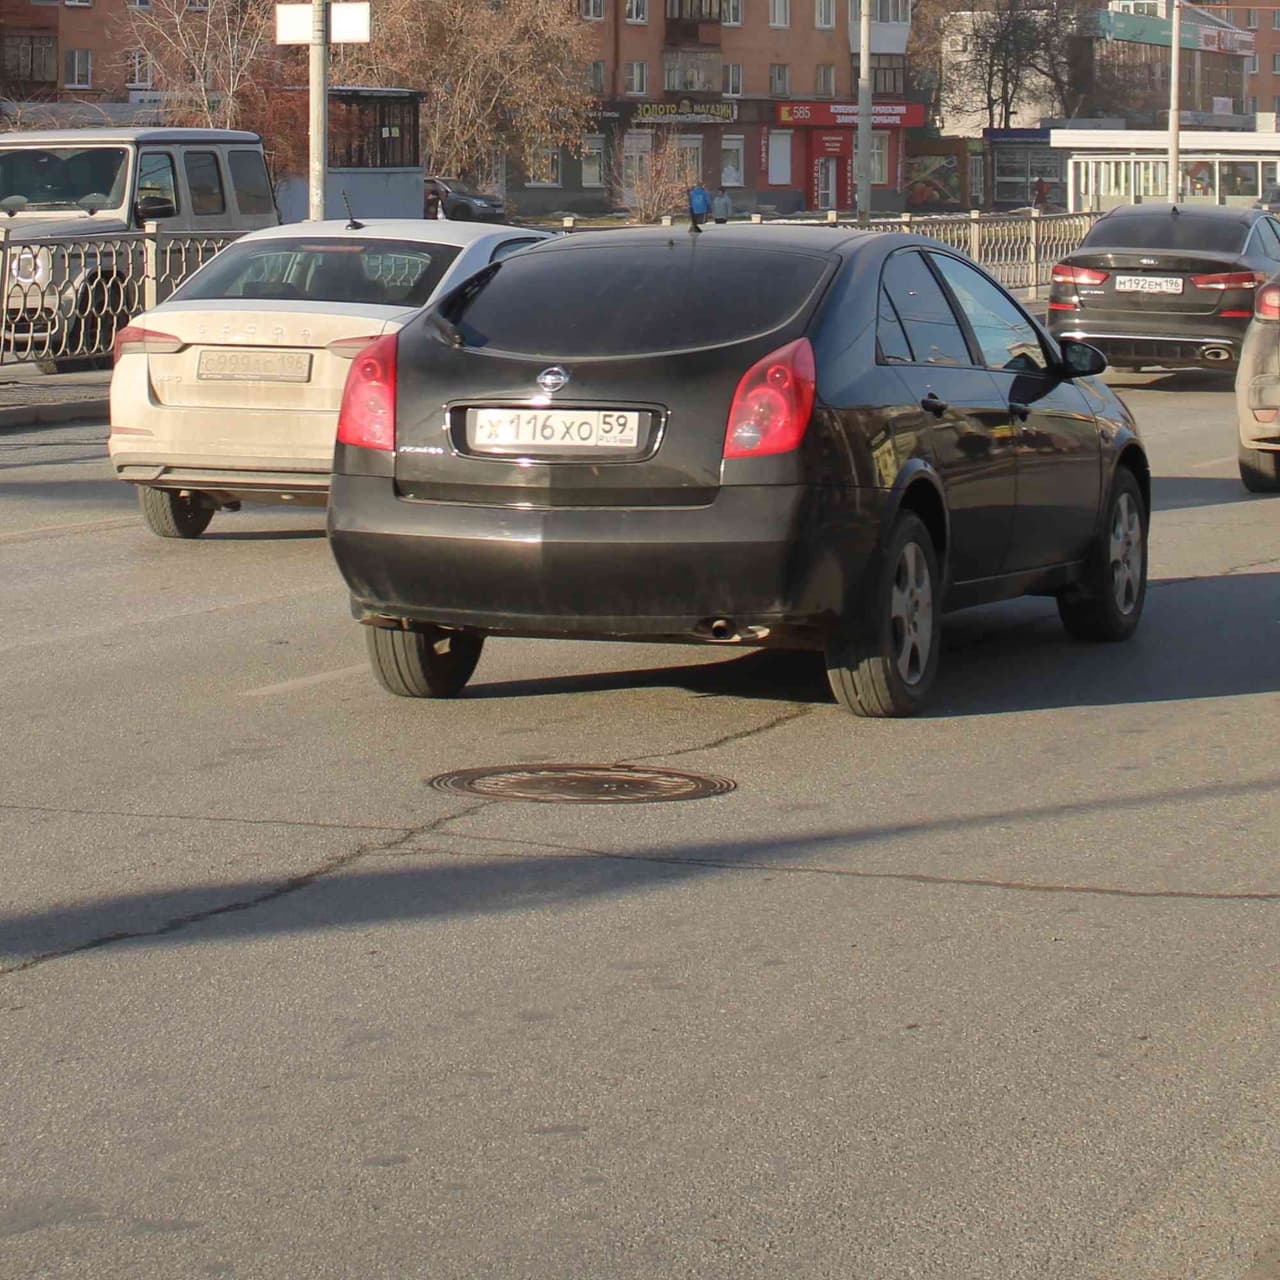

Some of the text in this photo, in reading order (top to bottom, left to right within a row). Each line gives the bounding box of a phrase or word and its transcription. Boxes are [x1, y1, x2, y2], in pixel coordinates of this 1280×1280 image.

[637, 103, 677, 118] ЗОЛОТО
[693, 103, 732, 118] МАГАЗИН
[793, 106, 811, 119] 585
[1165, 279, 1180, 288] 196
[601, 414, 629, 434] 59
